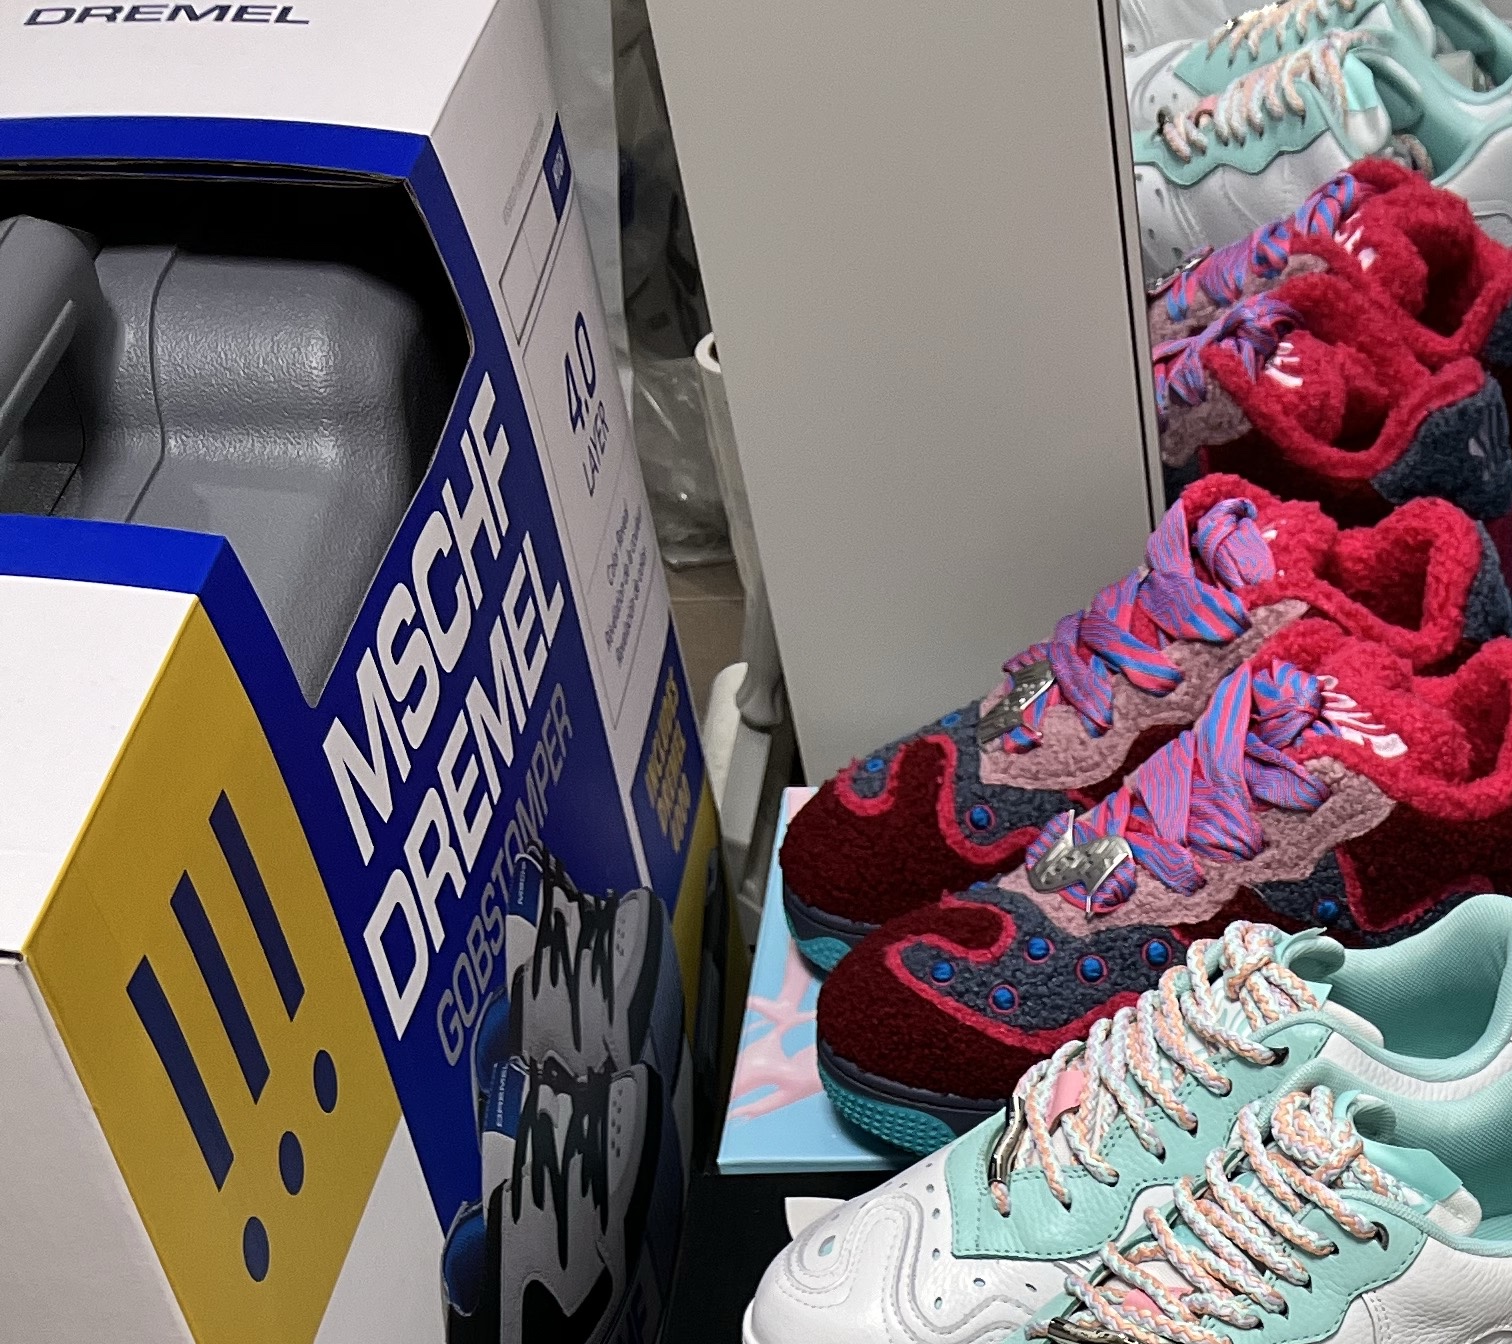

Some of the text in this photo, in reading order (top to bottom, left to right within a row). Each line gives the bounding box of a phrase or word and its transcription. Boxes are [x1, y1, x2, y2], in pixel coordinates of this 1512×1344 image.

[23, 4, 310, 26] DREMEL
[565, 310, 597, 434] 4.0
[582, 400, 610, 497] LAYER
[323, 372, 511, 867] MSCHF
[363, 531, 565, 1040] DREMEL
[436, 683, 574, 1066] GOBSTOMPER
